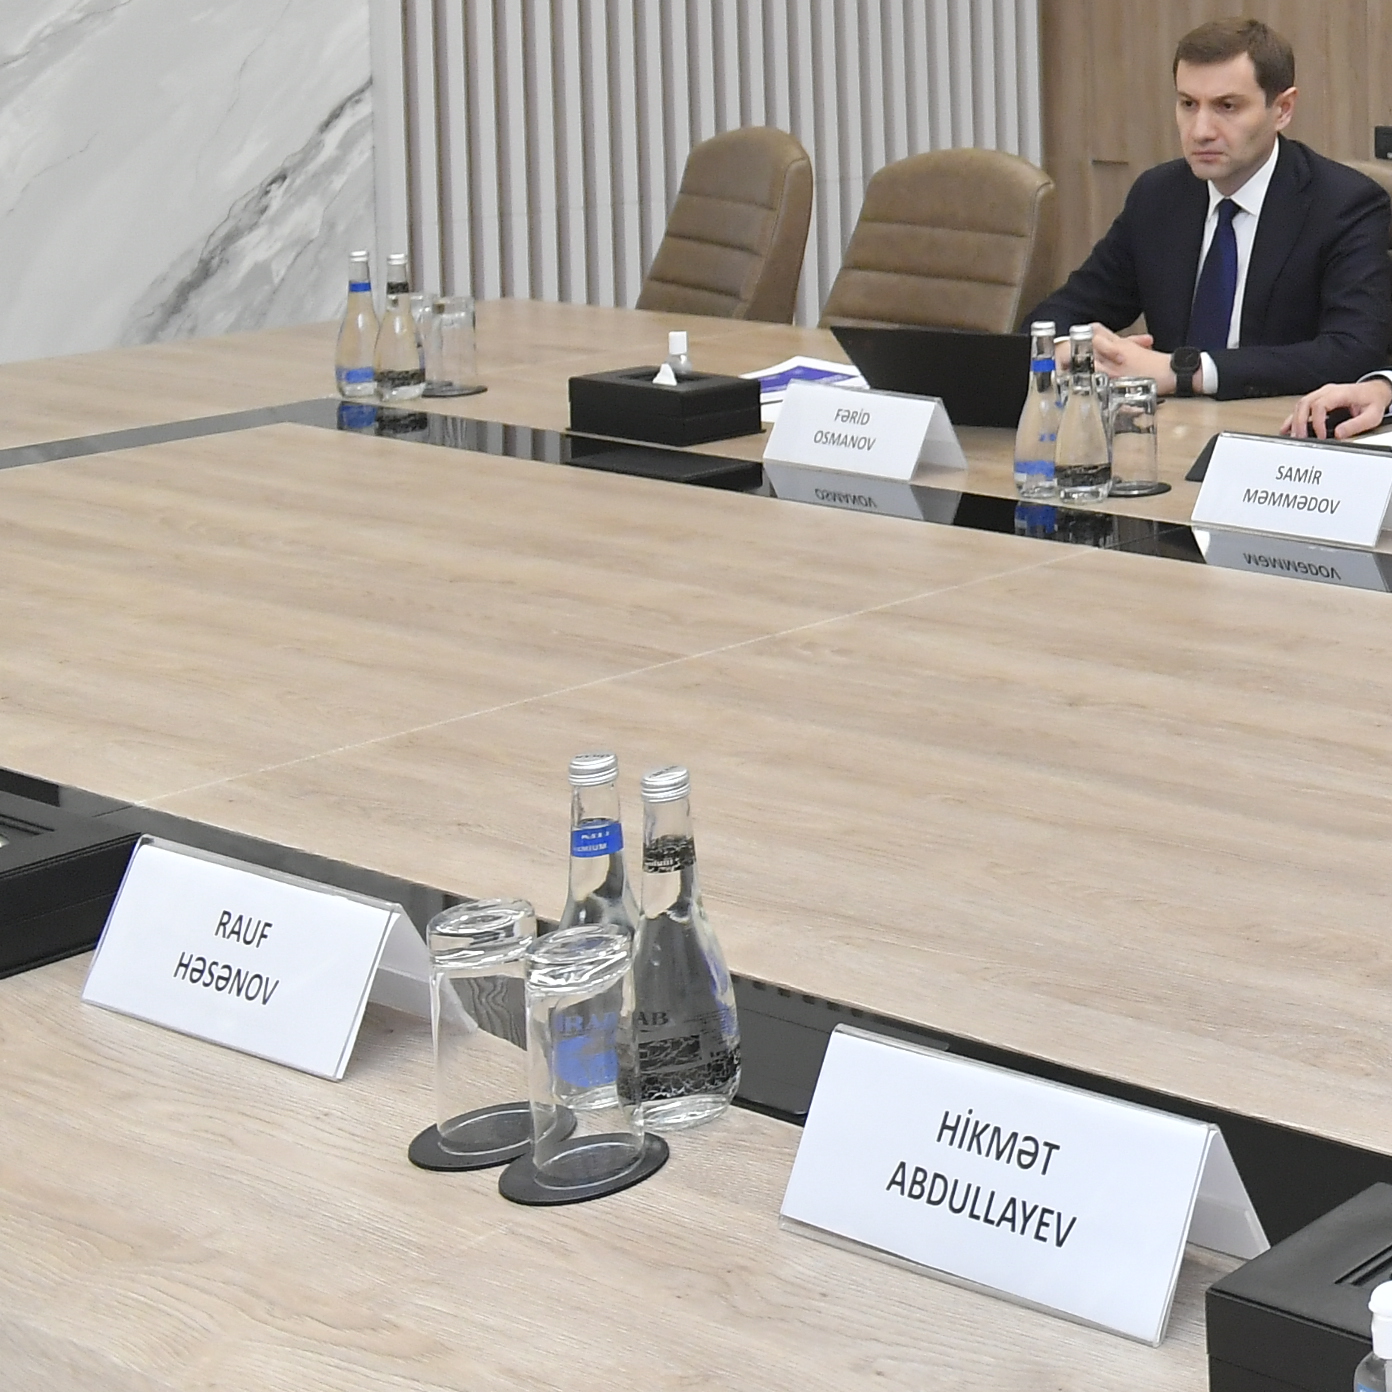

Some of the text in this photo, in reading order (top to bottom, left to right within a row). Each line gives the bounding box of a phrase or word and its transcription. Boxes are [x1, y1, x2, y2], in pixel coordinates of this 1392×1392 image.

[834, 407, 871, 426] FƏRİD
[813, 430, 877, 451] OSMANOV
[1275, 465, 1323, 486] SAMİR
[1242, 488, 1341, 515] MƏMMƏDOV
[214, 909, 273, 949] RAUF
[173, 951, 280, 1006] HƏSƏNOV
[935, 1107, 1061, 1176] HİKMƏT
[885, 1160, 1078, 1248] ABDULLAYEV
